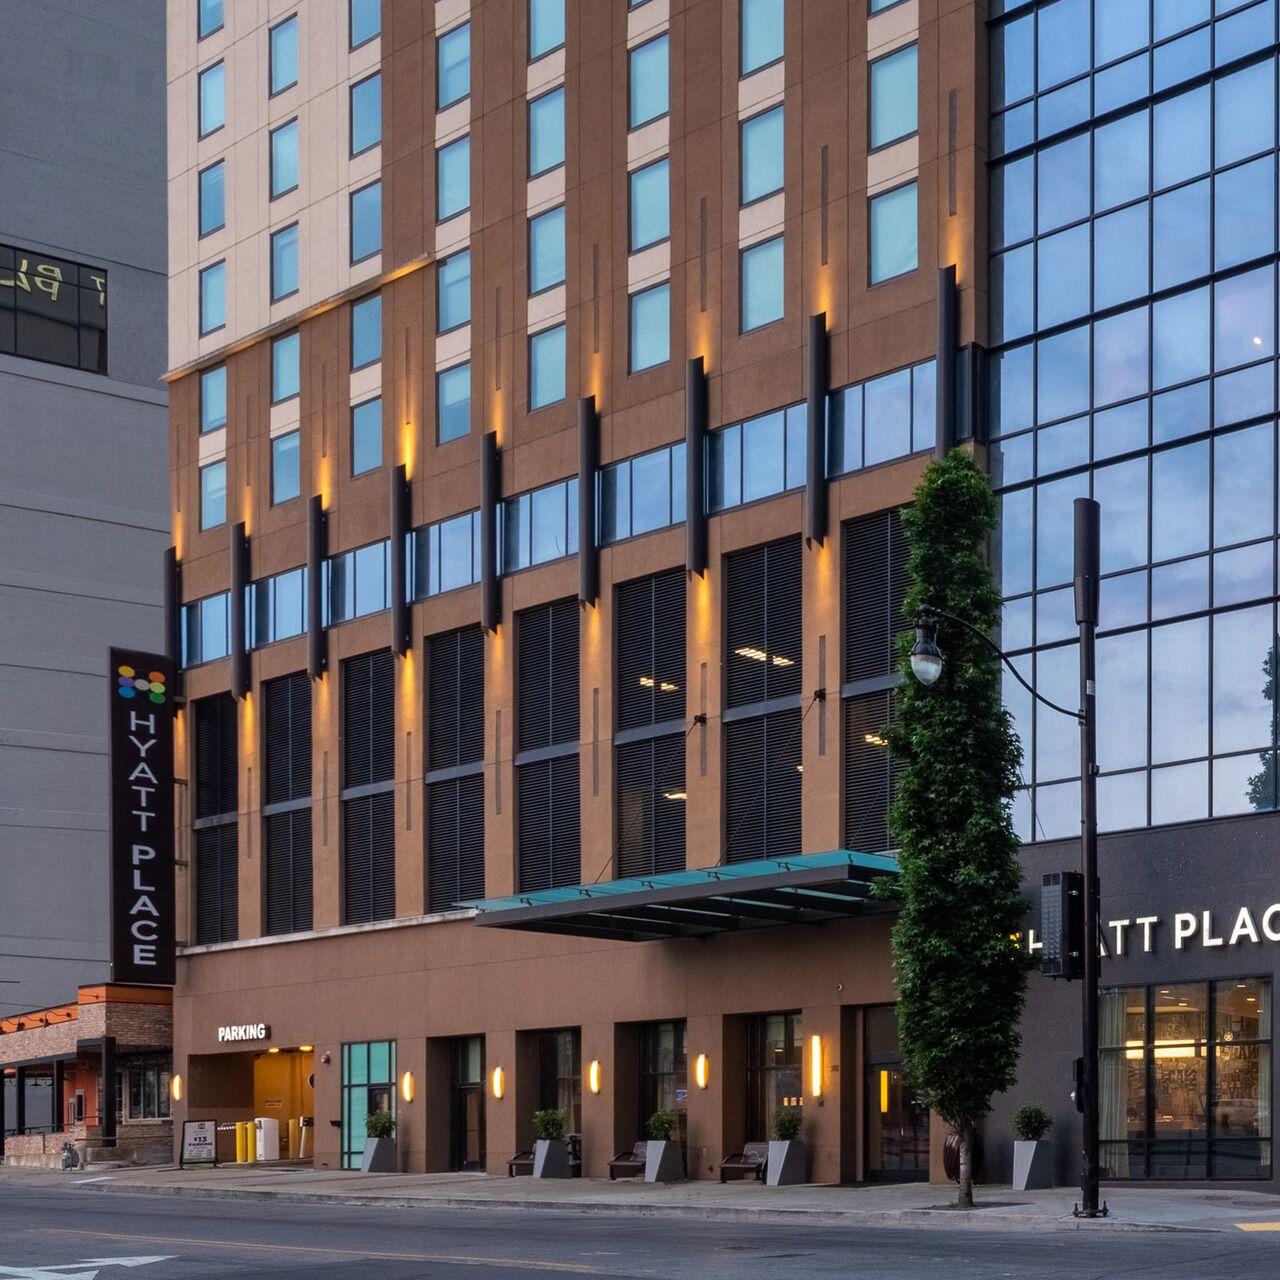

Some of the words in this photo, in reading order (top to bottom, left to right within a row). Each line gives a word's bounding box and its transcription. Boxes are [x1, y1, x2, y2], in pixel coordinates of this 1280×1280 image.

[128, 710, 159, 832] HYATT
[128, 844, 160, 966] PLACE
[217, 1023, 266, 1042] PARKING
